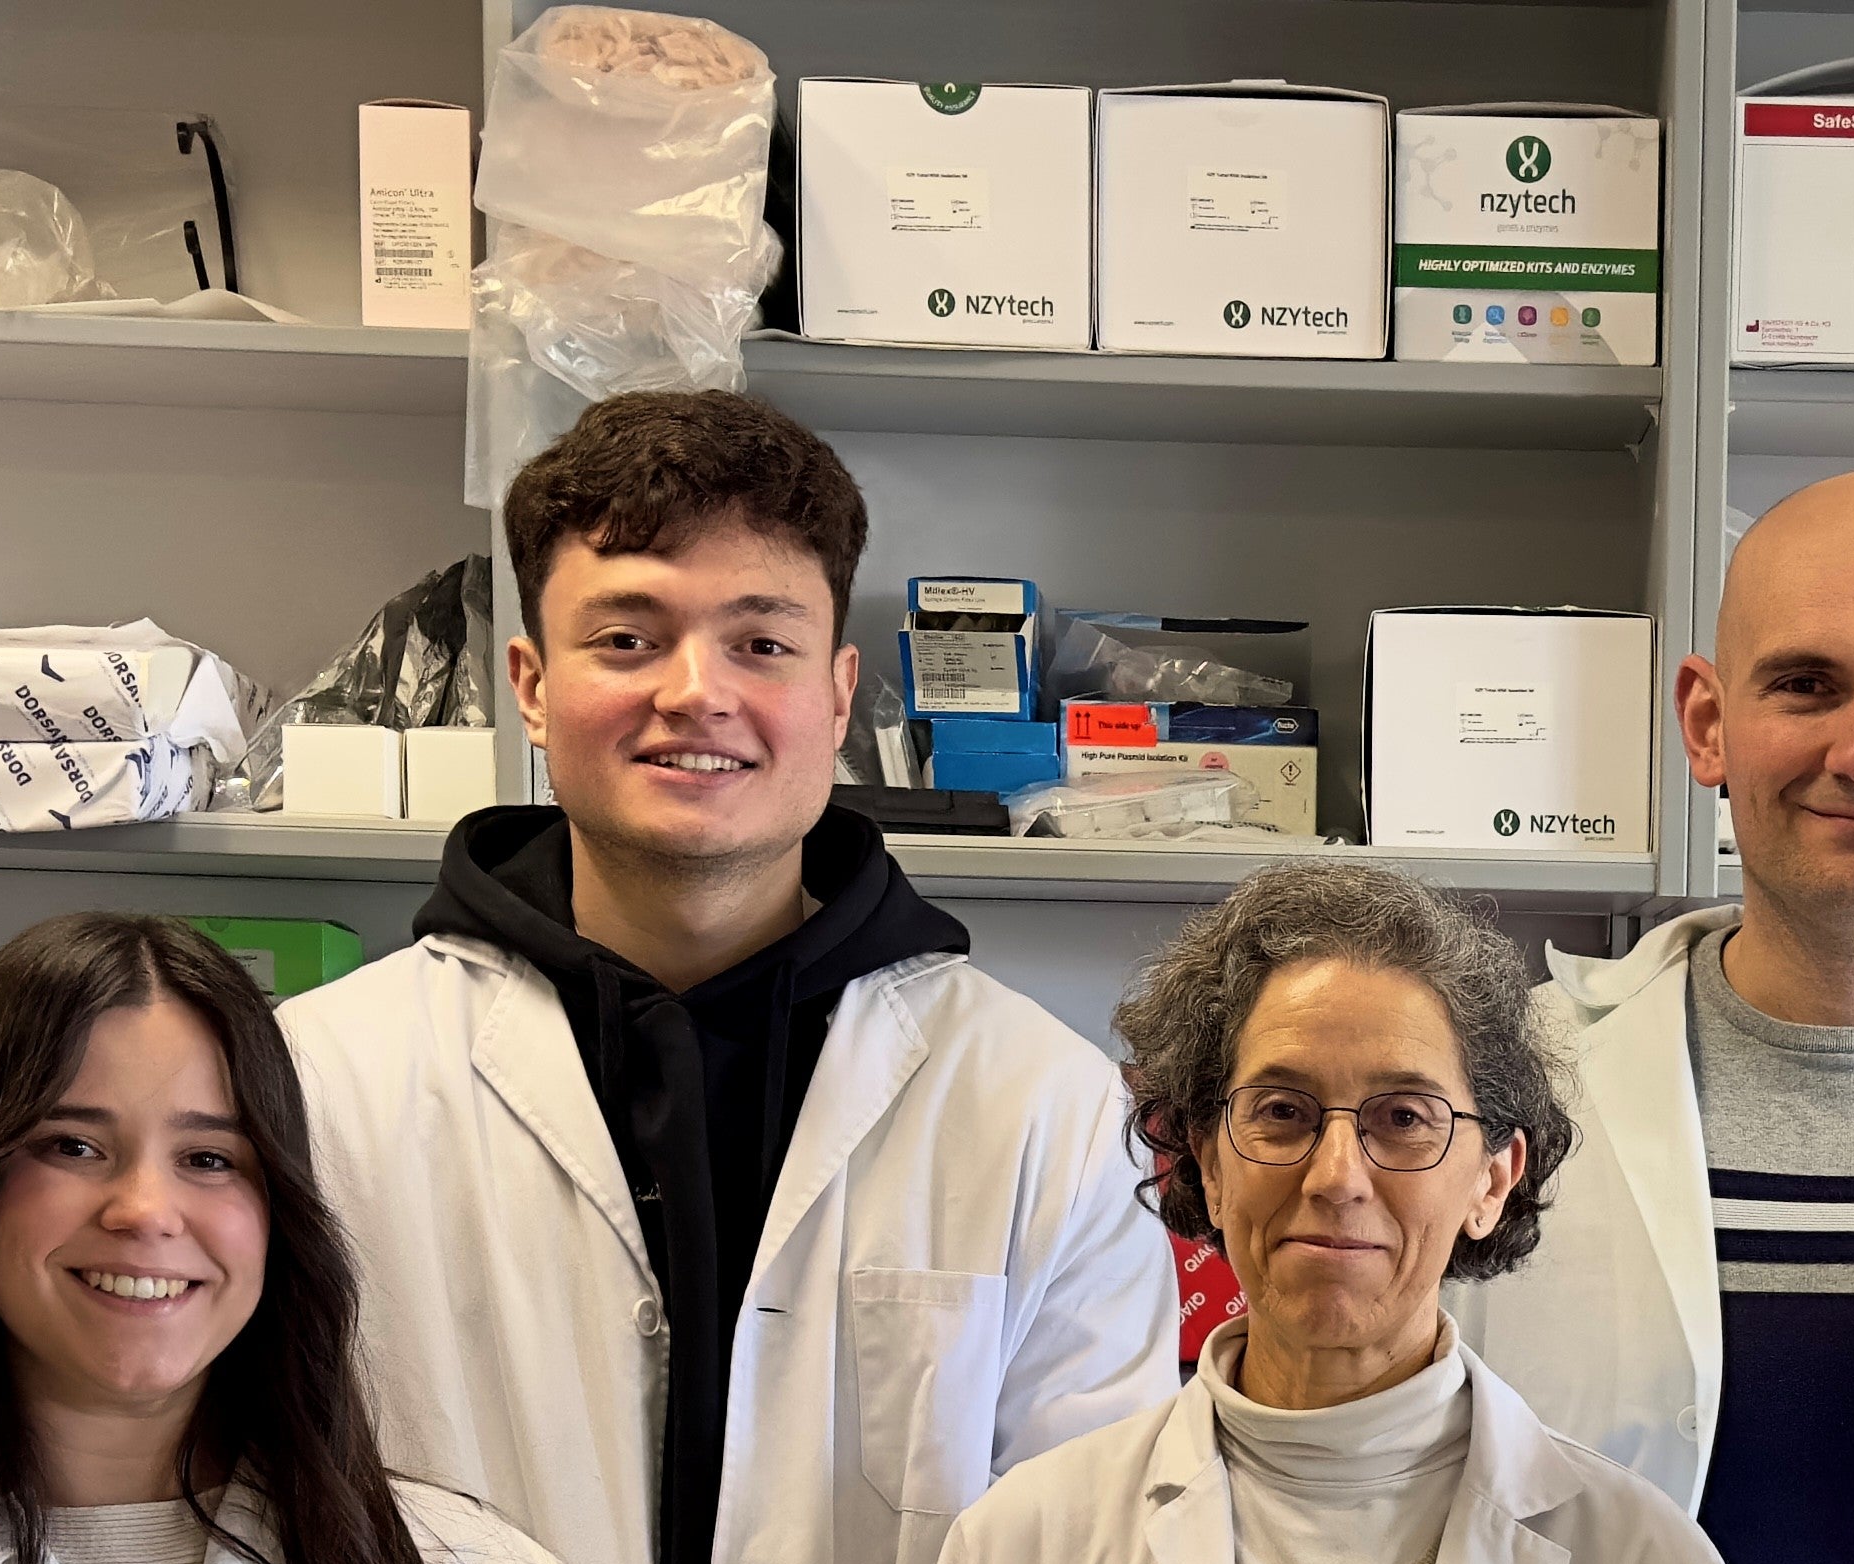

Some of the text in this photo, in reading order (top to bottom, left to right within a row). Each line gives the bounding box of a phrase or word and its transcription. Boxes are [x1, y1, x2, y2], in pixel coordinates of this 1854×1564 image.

[1480, 188, 1577, 219] nzytech
[1418, 258, 1637, 277] HIGHLY OPTIMIZED KITS AND ENZYMES
[966, 294, 1055, 317] NZYtech
[1261, 305, 1349, 328] NZYtech
[1098, 721, 1116, 731] This
[1081, 752, 1098, 761] High
[1099, 752, 1117, 761] Pure
[1117, 752, 1145, 762] Plasmid
[1146, 753, 1177, 762] Isolation
[1530, 813, 1616, 835] NZYtech
